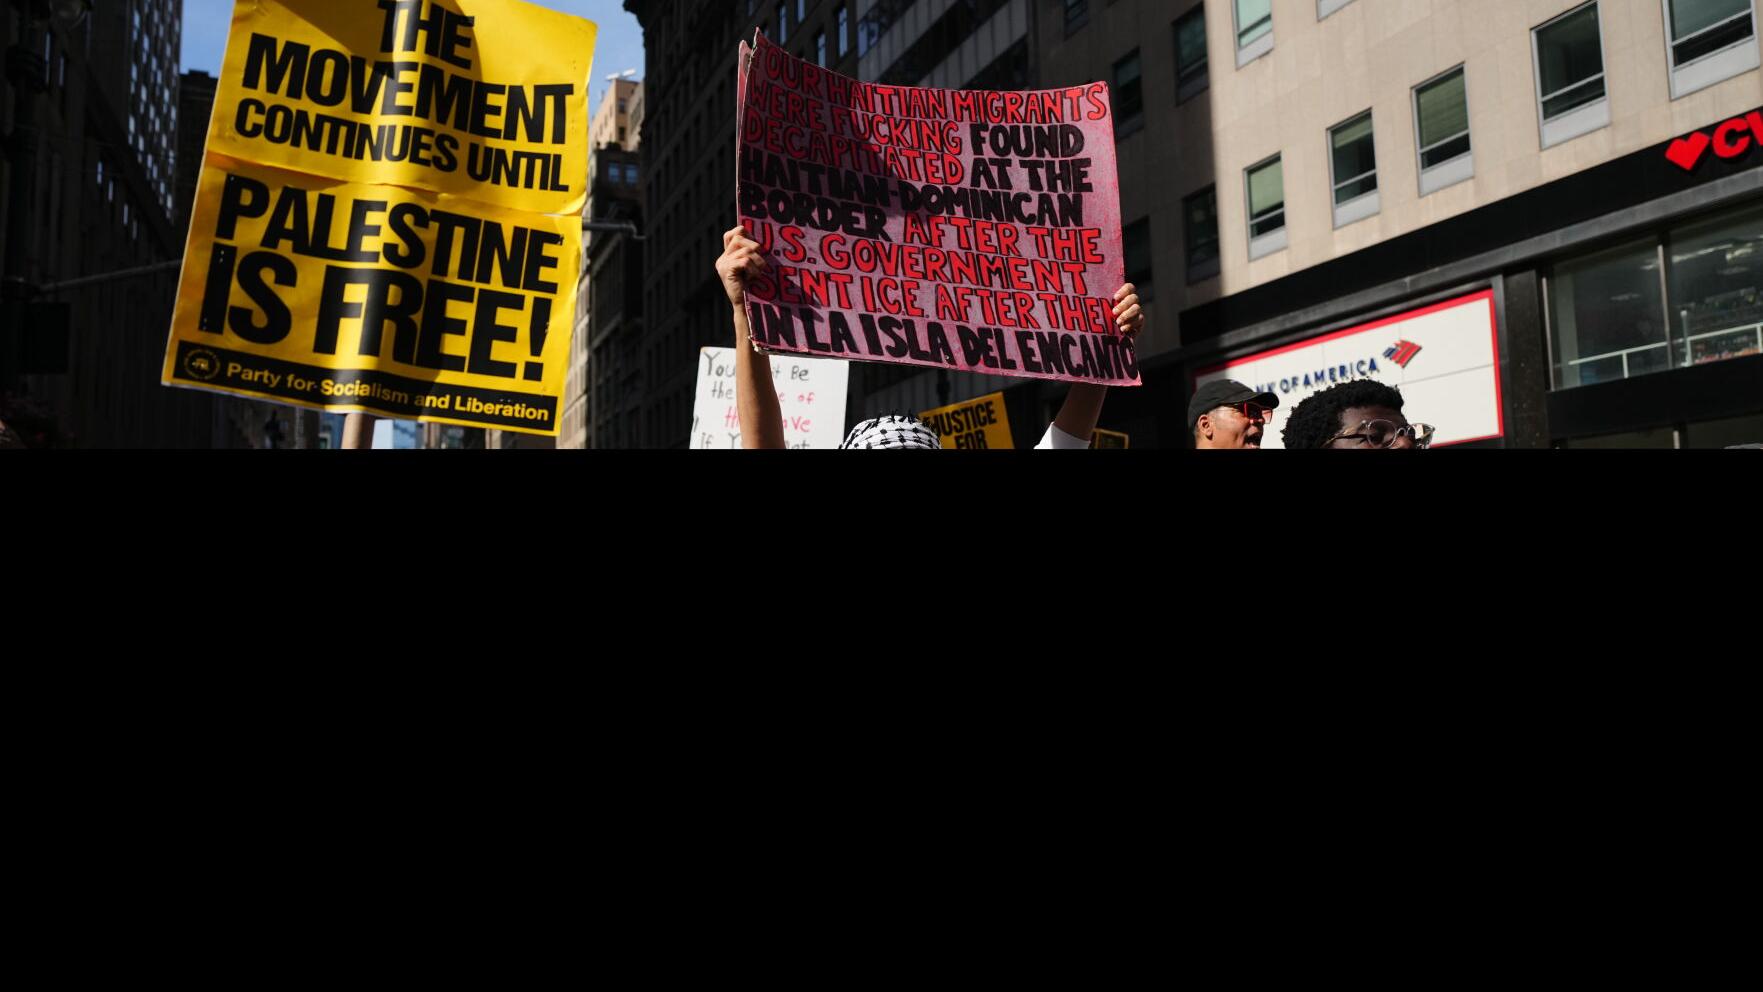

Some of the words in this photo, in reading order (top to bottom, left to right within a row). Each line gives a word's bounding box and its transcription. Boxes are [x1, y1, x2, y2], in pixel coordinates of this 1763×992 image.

[377, 0, 475, 69] THE
[242, 33, 574, 144] MOVEMENT
[750, 68, 826, 131] WERE
[831, 107, 962, 155] FUCKING
[970, 123, 1085, 158] FOUND
[826, 73, 946, 121] HAITIAN
[952, 83, 1107, 124] MIGRANTS
[235, 98, 459, 173] CONTINUES
[467, 143, 569, 192] UNTIL
[745, 106, 964, 185] DECAPITATED
[971, 157, 1013, 190] AT
[1019, 158, 1093, 193] THE
[740, 180, 892, 241] BORDER
[904, 212, 1021, 257] AFTER
[1026, 226, 1104, 264] THE
[741, 143, 1084, 227] HAITIAN-DOMINICAN
[215, 174, 559, 295] PALESTINE
[742, 218, 817, 264] U.S.
[820, 233, 1088, 295] GOVERNMENT
[199, 242, 297, 345] IS
[313, 265, 552, 382] FREE!
[750, 265, 853, 310] SENT
[935, 283, 1041, 330] AFTER
[704, 352, 737, 378] You
[790, 365, 810, 381] Be
[750, 302, 798, 347] IN
[801, 307, 861, 354] LA
[858, 313, 957, 366] ISLA
[956, 324, 1017, 370] DEL
[1015, 330, 1139, 381] ENCANTO
[1280, 376, 1298, 394] OF
[1302, 358, 1379, 387] AMERICA
[227, 362, 281, 388] Party
[287, 374, 315, 391] for
[321, 378, 408, 404] Socialism
[415, 393, 450, 409] and
[454, 396, 549, 421] Liberation
[711, 381, 735, 400] the
[797, 392, 816, 404] of
[954, 429, 988, 449] FOR
